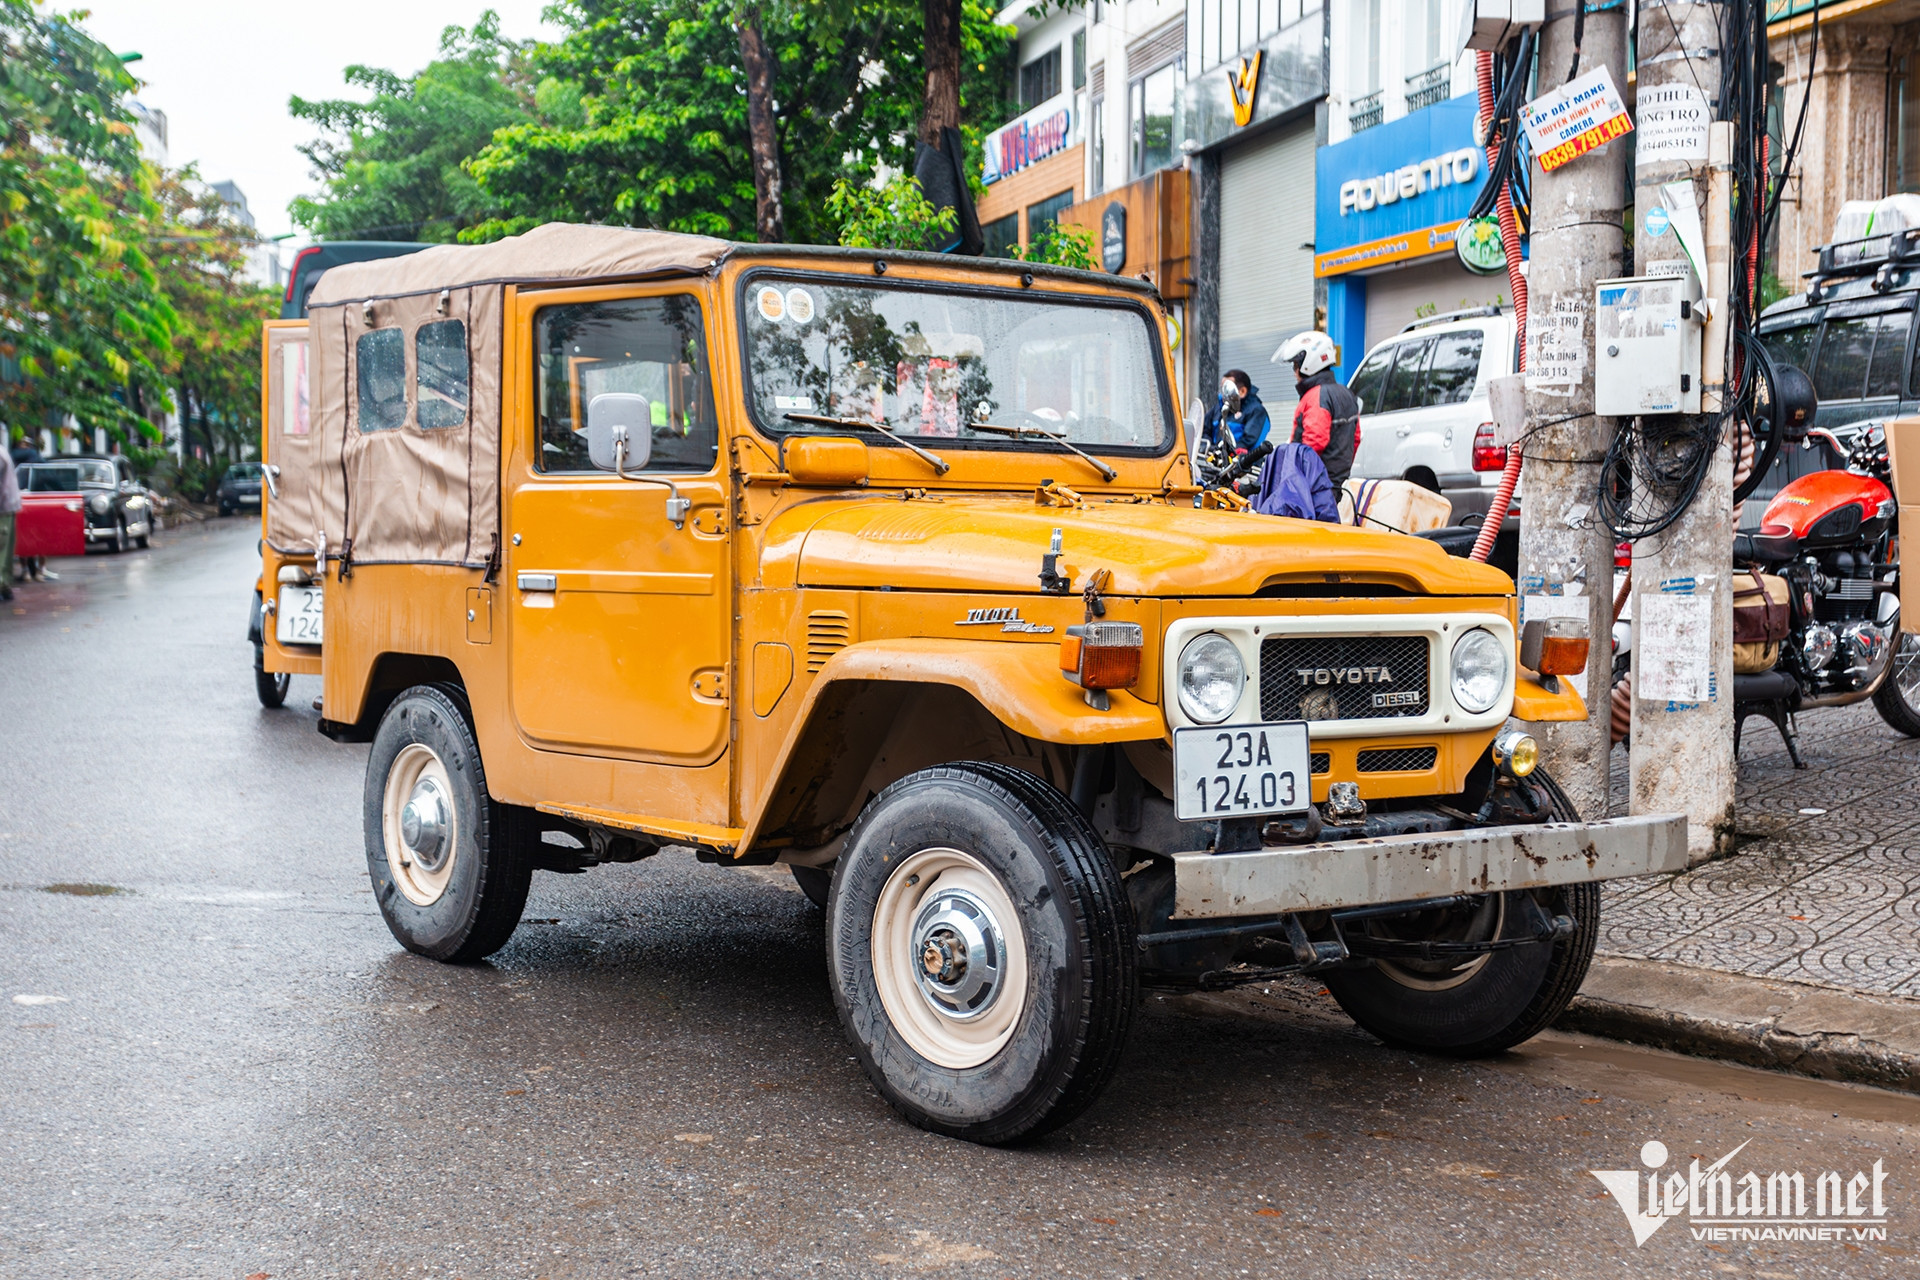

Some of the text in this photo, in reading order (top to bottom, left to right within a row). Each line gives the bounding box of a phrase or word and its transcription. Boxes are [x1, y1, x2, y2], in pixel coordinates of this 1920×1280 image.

[1540, 113, 1632, 172] 0339.791.141
[1559, 116, 1595, 140] CAMERA
[966, 607, 1020, 622] TOYOTA
[1296, 665, 1393, 686] TOYOTA
[1375, 692, 1419, 707] DIESEL
[1215, 730, 1273, 770] 23A
[1195, 769, 1297, 814] 124.03
[839, 845, 876, 1006] BRIDGESTONE
